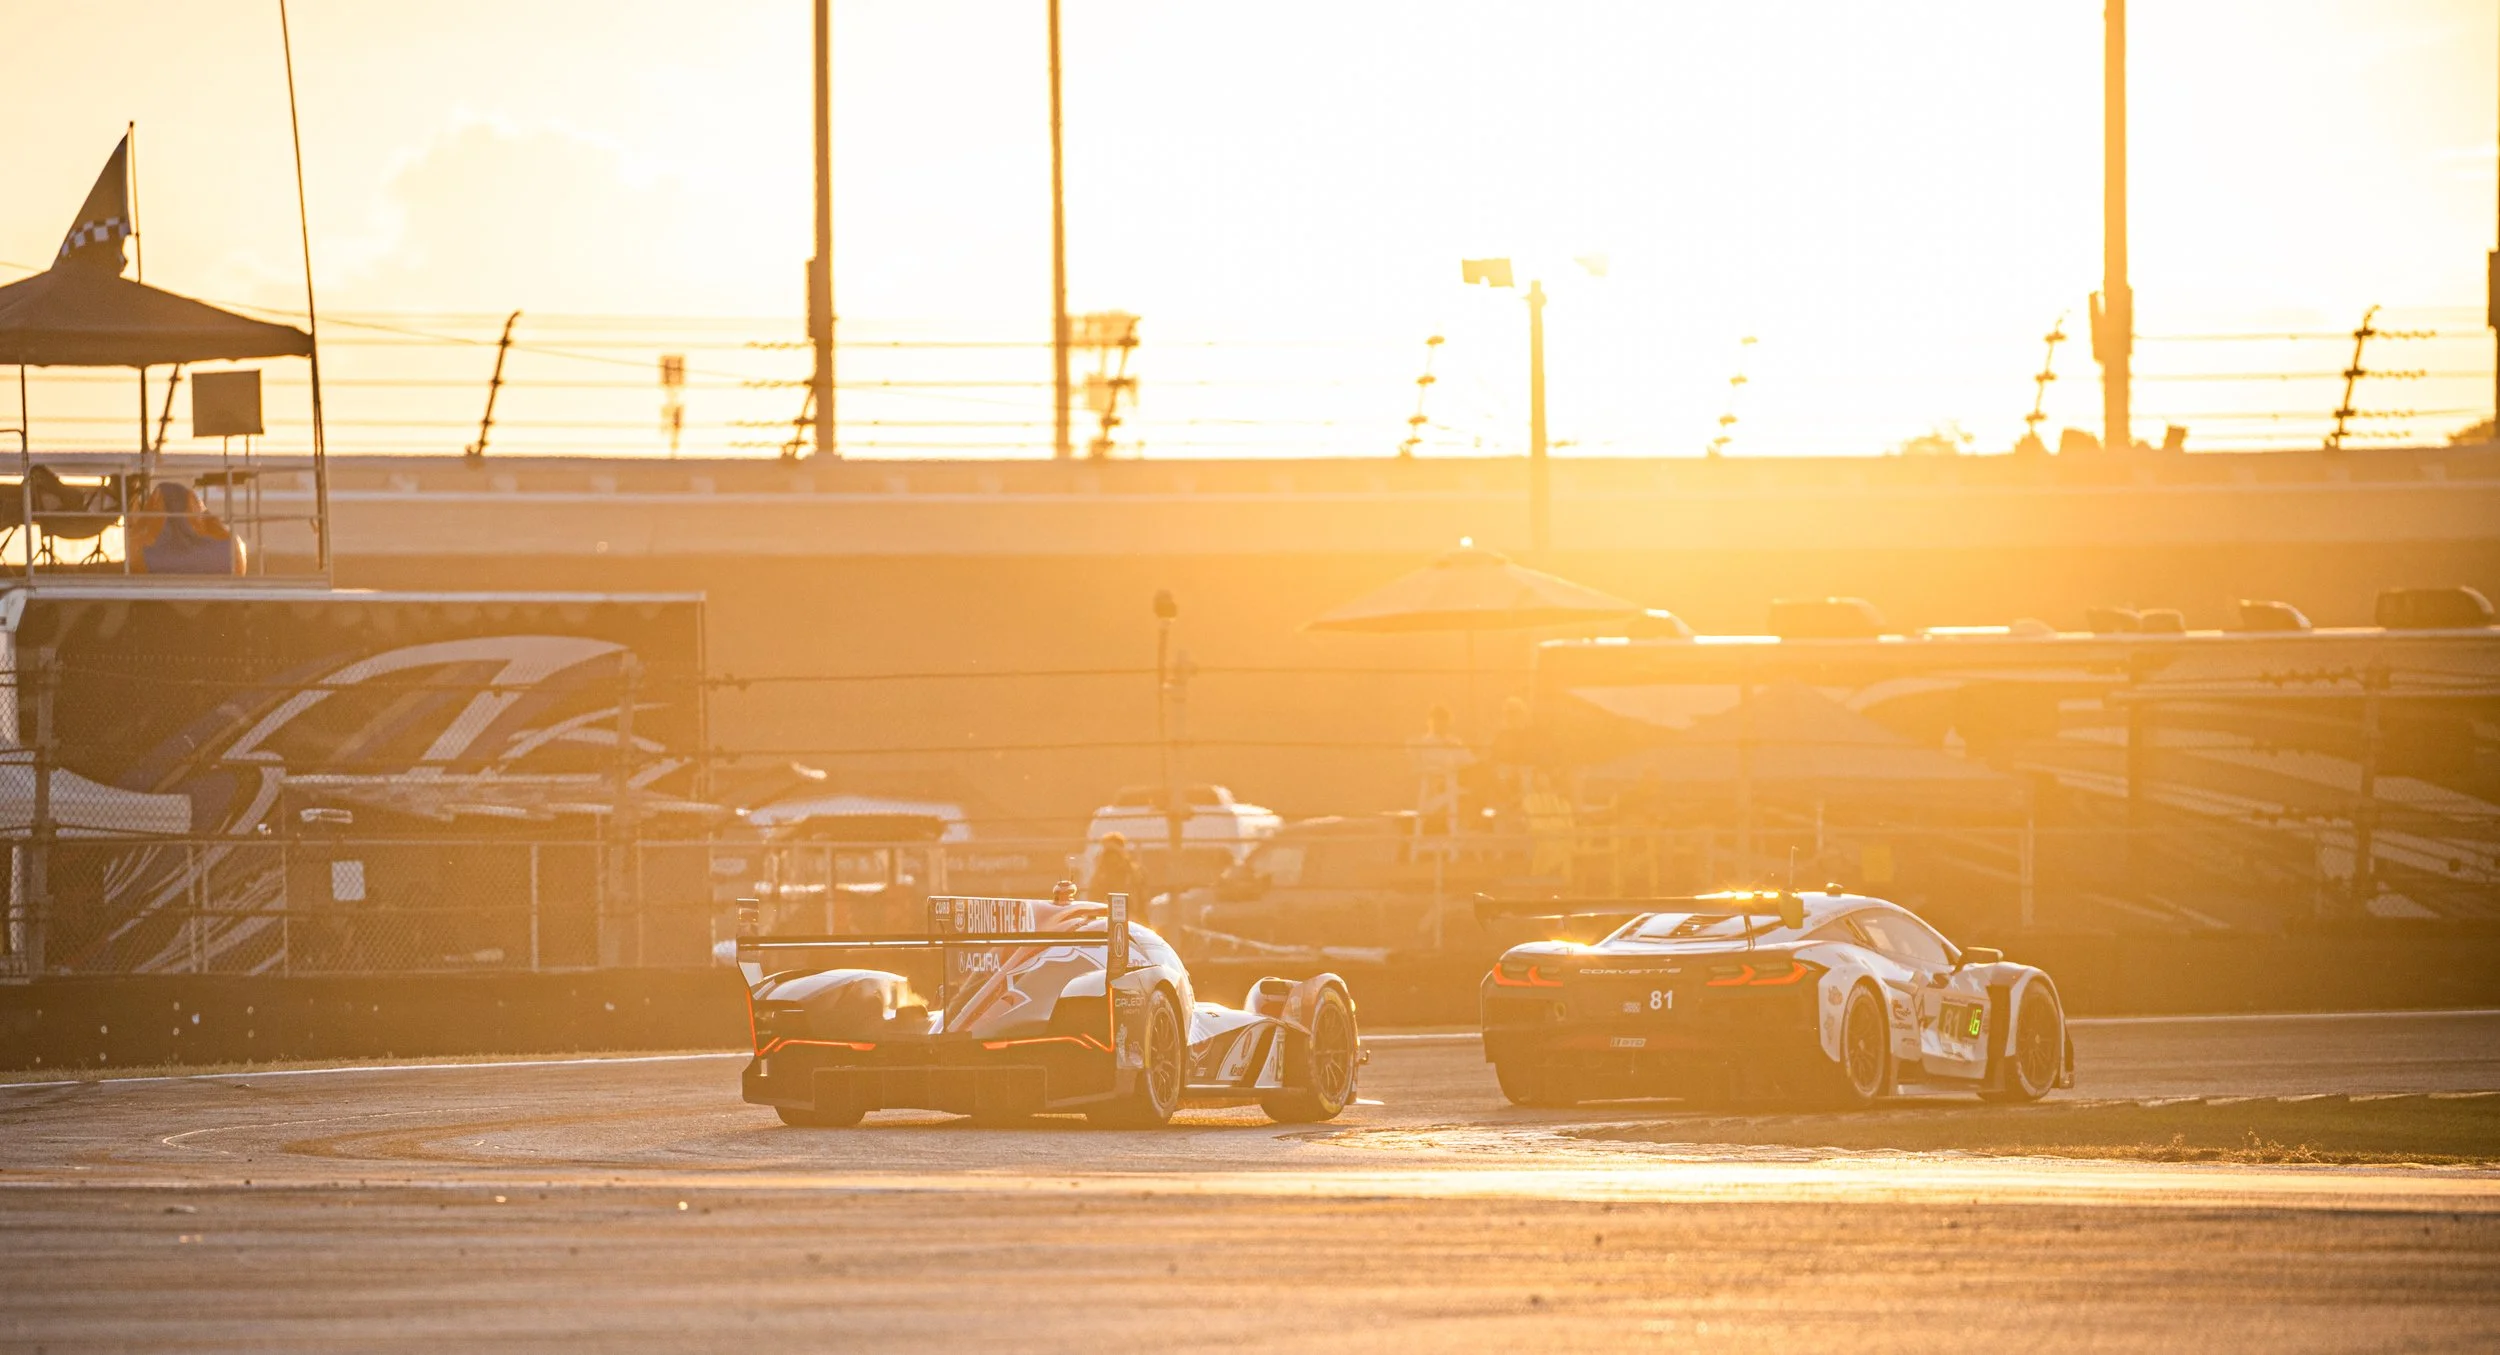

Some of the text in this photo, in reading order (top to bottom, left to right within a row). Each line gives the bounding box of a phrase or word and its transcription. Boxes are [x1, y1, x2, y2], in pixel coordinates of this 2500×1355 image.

[967, 899, 997, 933] BRING
[998, 900, 1016, 933] THE
[966, 952, 1001, 972] ACURA
[1579, 967, 1682, 975] CORVETTE
[1650, 990, 1673, 1009] 81
[1944, 1009, 1959, 1040] 81
